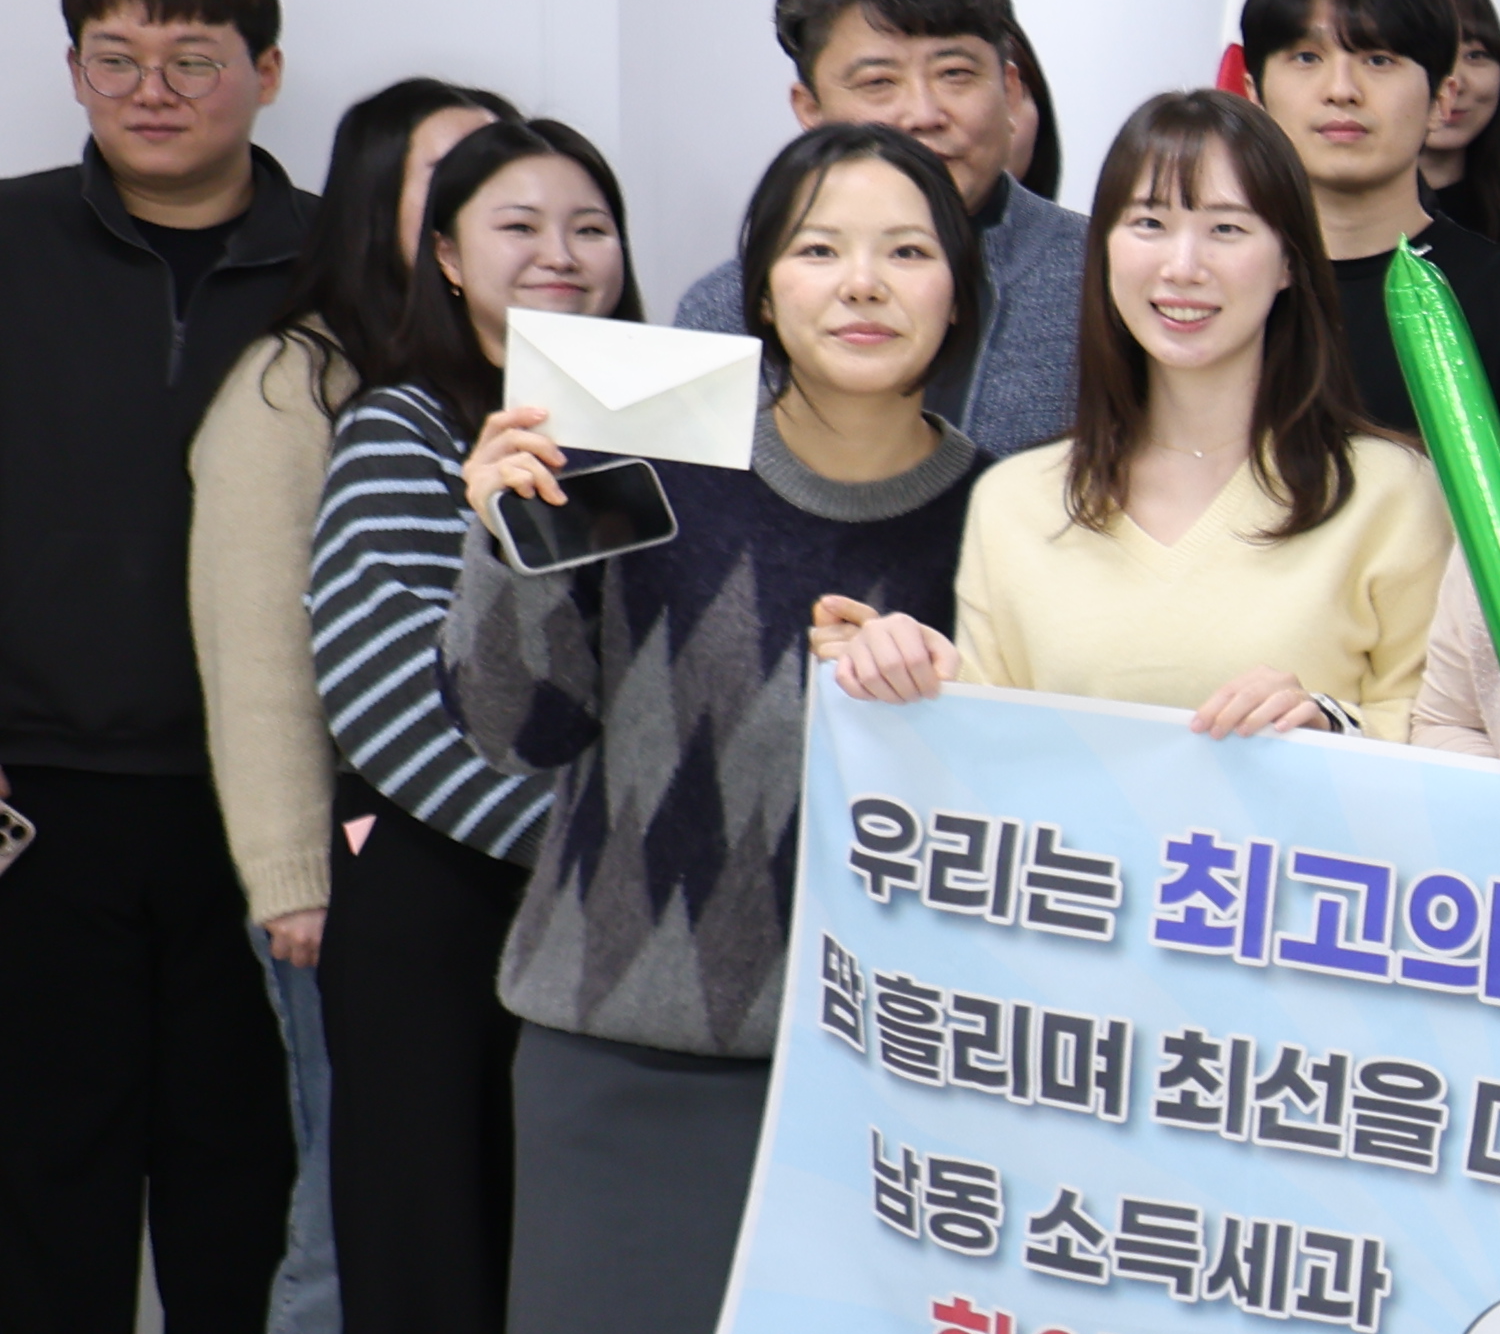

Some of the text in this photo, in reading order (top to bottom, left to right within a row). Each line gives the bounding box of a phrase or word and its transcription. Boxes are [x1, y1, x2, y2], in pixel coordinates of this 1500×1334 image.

[849, 796, 1119, 937] 우리는
[822, 932, 864, 1048] 땀
[873, 972, 1130, 1119] 흘리며
[1155, 1030, 1446, 1169] 최선을
[871, 1129, 1391, 1328] 남동 소득세과
